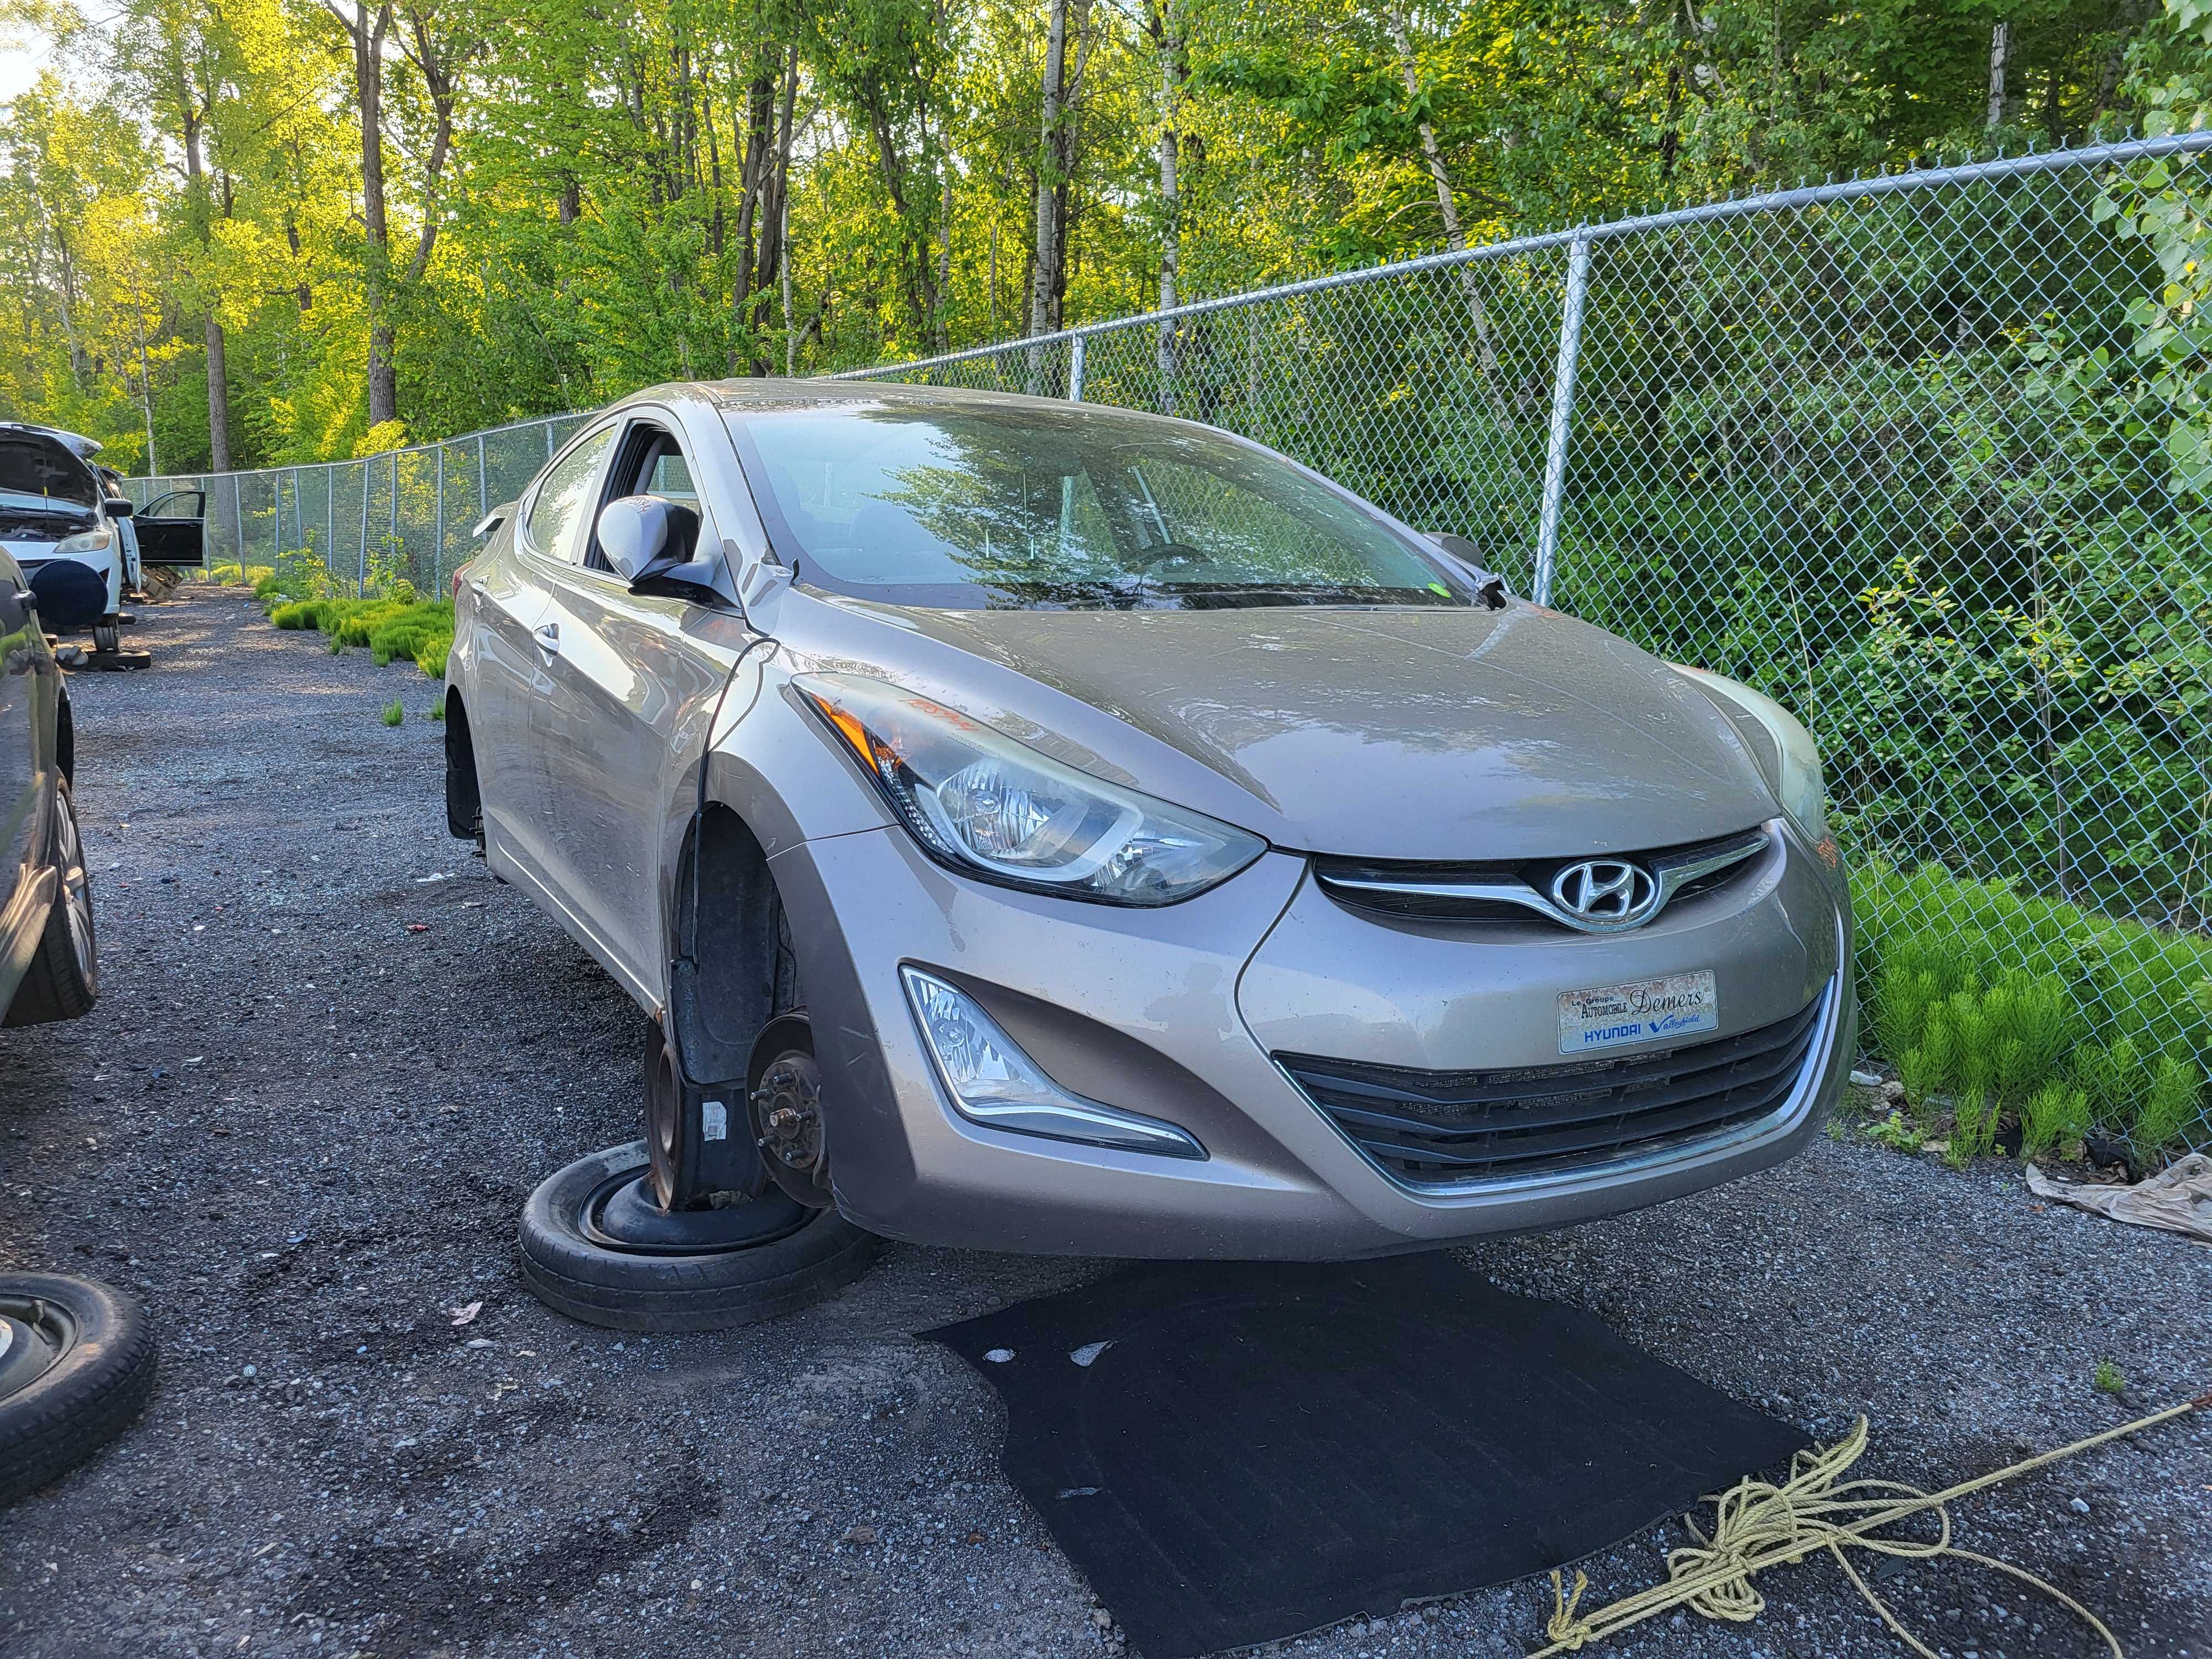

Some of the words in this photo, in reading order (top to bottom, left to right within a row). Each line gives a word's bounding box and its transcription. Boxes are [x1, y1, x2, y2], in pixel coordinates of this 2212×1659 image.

[1581, 1003, 1628, 1019] AUTOMOBILE
[1630, 987, 1704, 1015] Demers
[1586, 996, 1614, 1005] Groupe
[1584, 1024, 1641, 1042] HYUNDAI
[1648, 1015, 1701, 1034] Valleyfield
